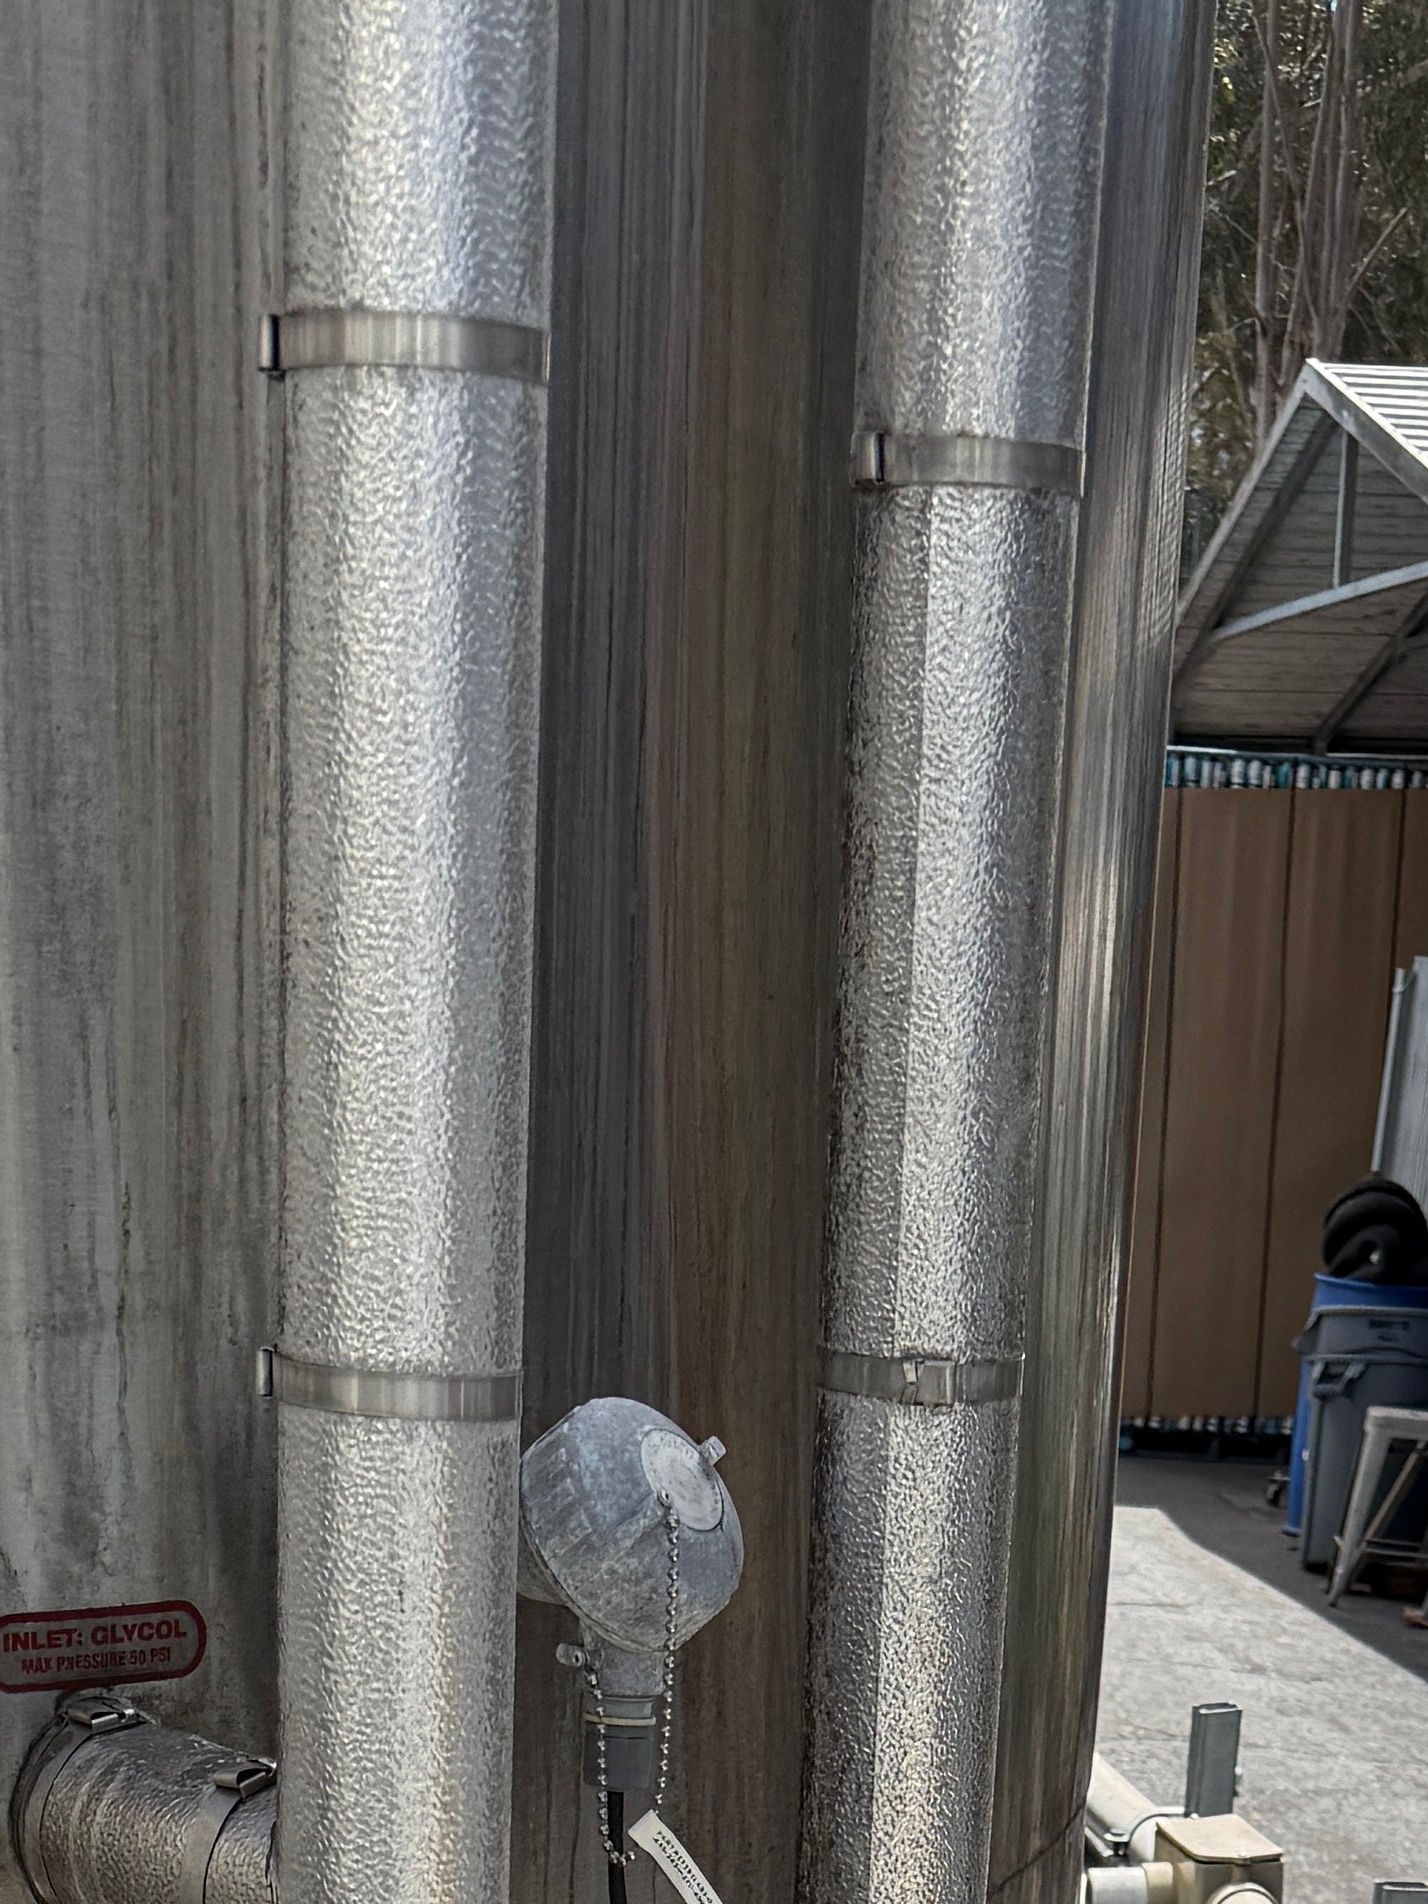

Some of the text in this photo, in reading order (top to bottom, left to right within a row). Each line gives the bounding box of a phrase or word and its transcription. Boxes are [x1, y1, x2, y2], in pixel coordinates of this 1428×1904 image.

[3, 1619, 187, 1653] INLET: GLYCOL
[21, 1656, 52, 1674] MAX
[56, 1651, 125, 1673] PRESSURE
[150, 1647, 171, 1664] PSI
